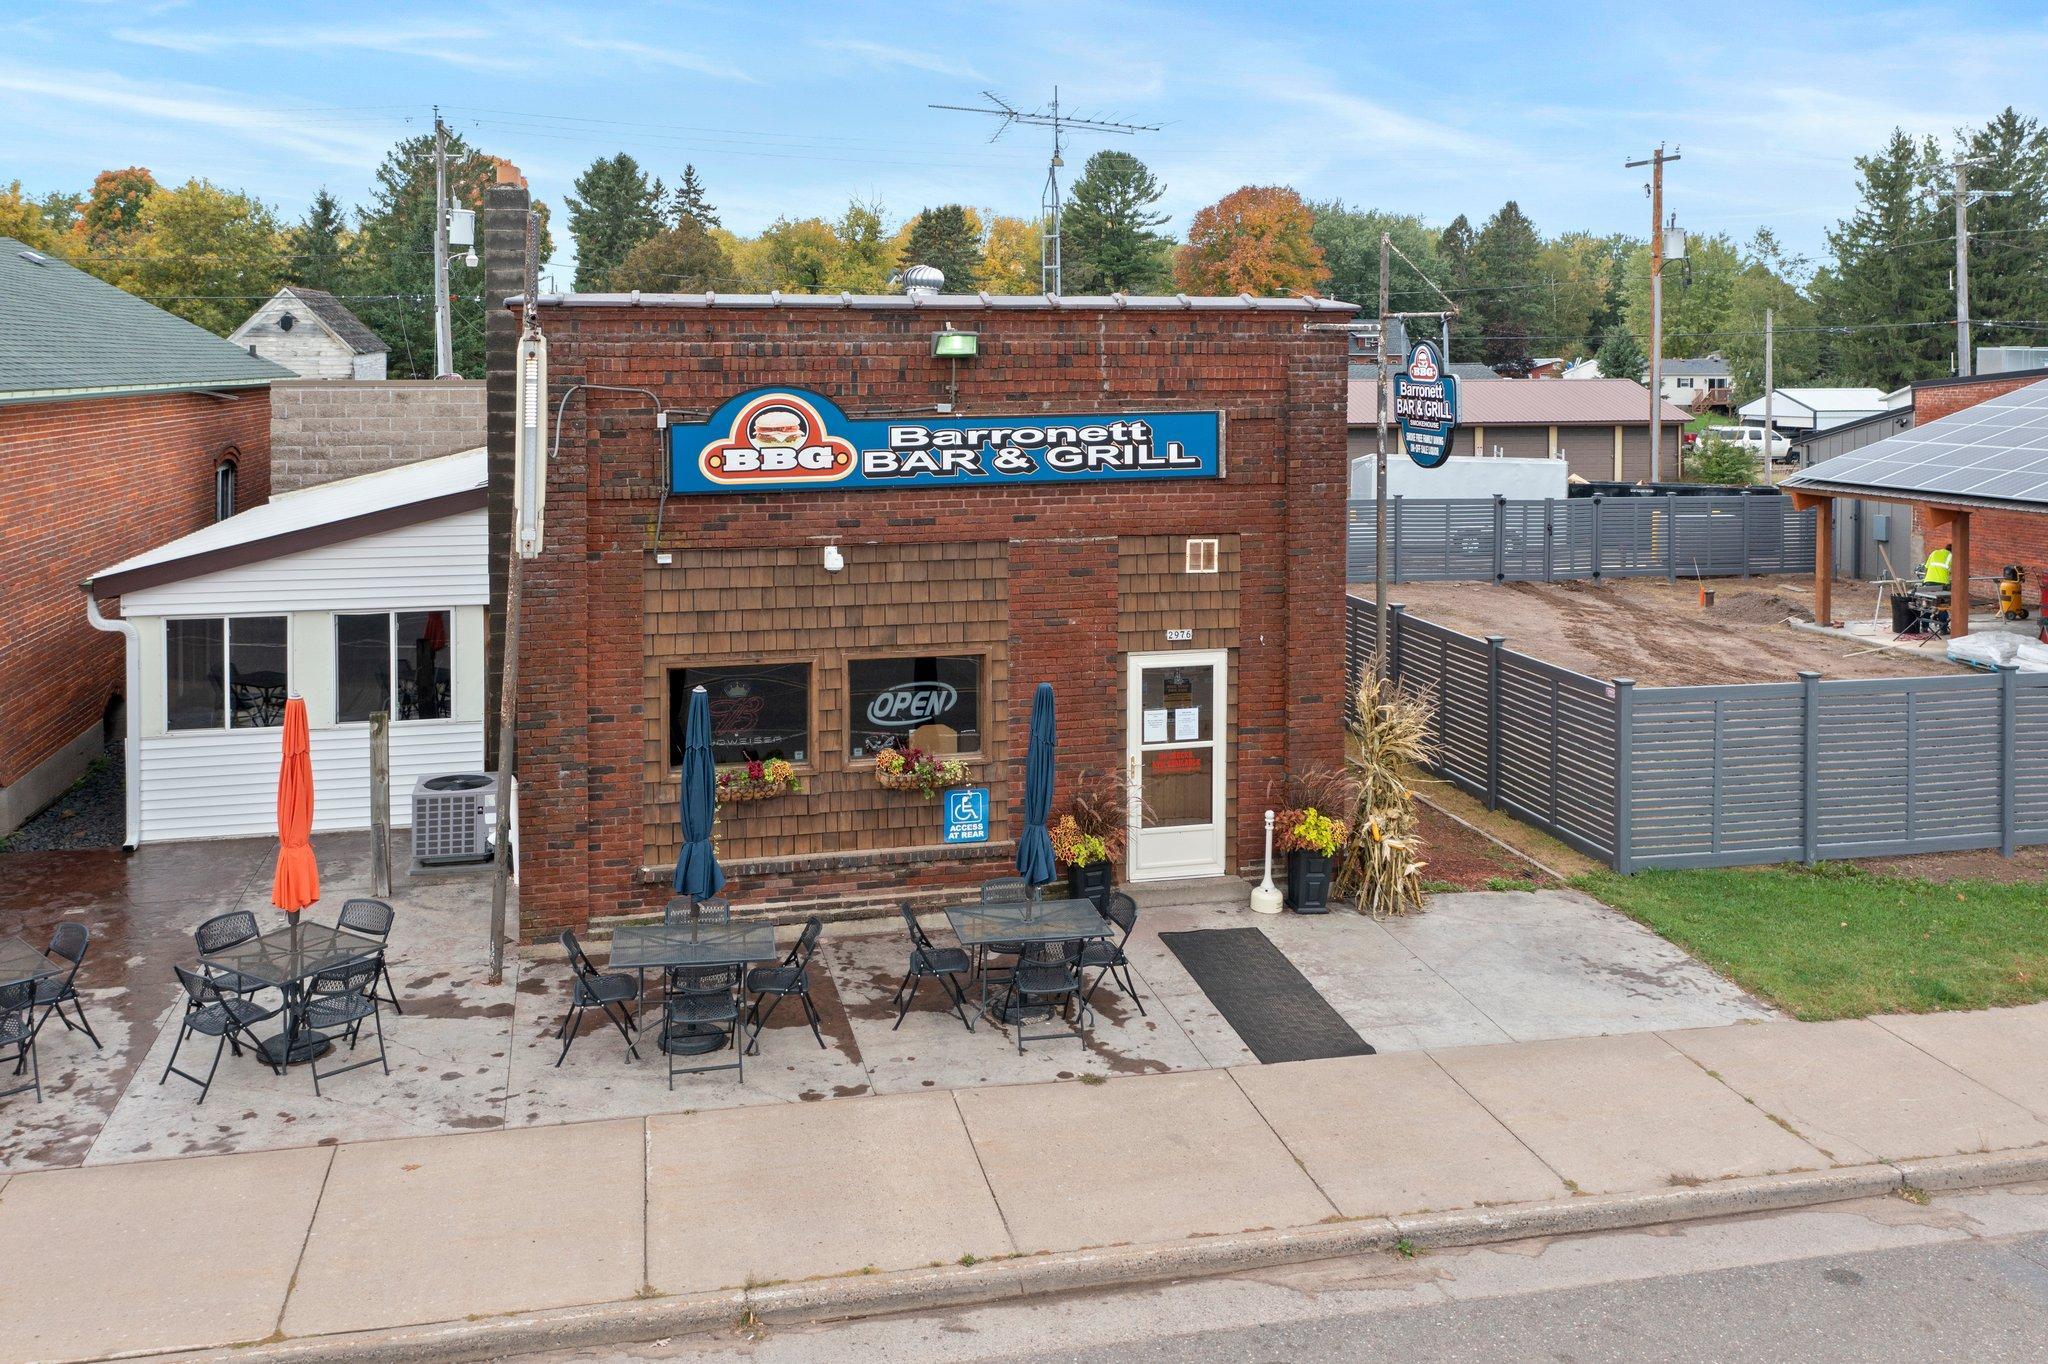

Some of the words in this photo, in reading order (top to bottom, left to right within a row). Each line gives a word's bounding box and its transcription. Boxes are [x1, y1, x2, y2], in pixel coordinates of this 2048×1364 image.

[1413, 367, 1434, 377] BBG
[1400, 381, 1443, 398] Barronett
[1397, 398, 1415, 415] BAR
[1416, 400, 1423, 416] &
[1425, 401, 1452, 418] GRILL
[1410, 420, 1439, 428] SMOKEHOUSE
[892, 421, 1150, 447] Barronett
[723, 446, 836, 472] BBG
[863, 448, 968, 473] BAR
[996, 447, 1032, 469] &
[1047, 442, 1198, 467] GRILL
[1168, 630, 1191, 639] 2976
[871, 690, 948, 718] OPEN
[948, 832, 959, 840] AT
[961, 831, 984, 839] REAR
[950, 823, 983, 832] ACCESS
